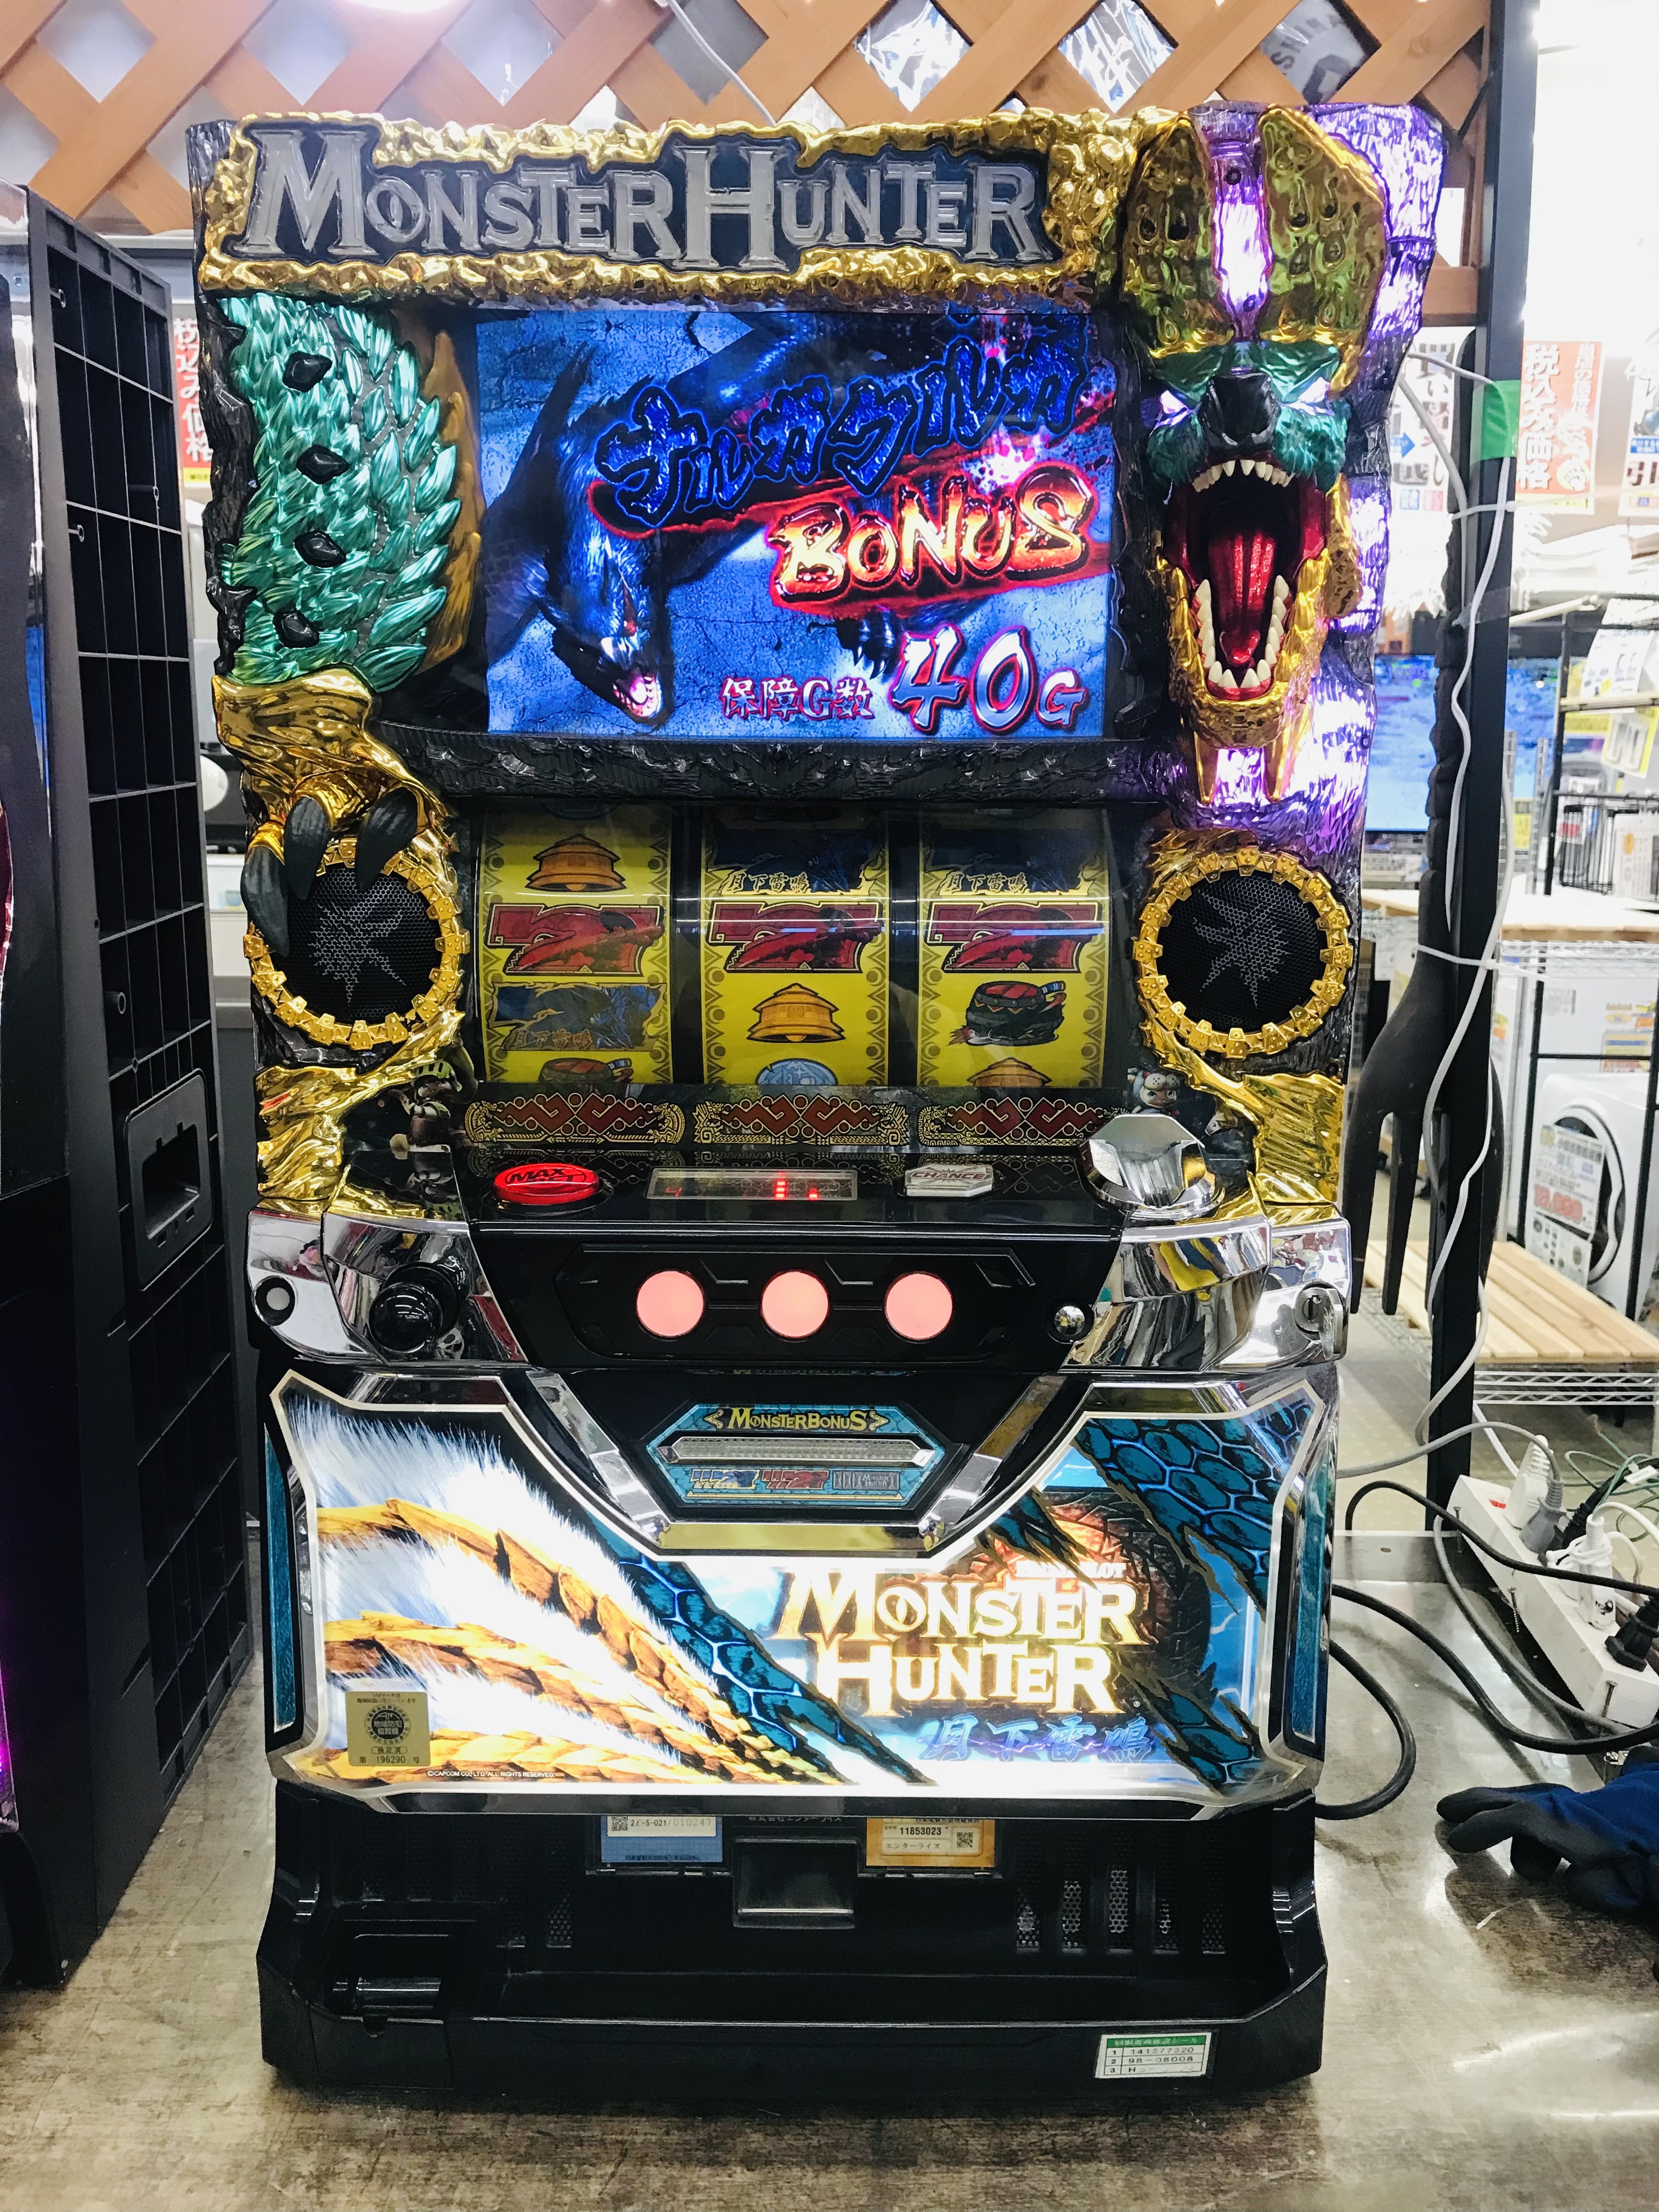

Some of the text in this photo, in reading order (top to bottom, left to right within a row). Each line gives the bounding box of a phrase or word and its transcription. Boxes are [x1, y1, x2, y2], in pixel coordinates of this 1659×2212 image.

[236, 129, 1049, 270] MONSTER HUNTER
[1516, 343, 1560, 489] 税込み価格
[770, 471, 1092, 600] BONUS
[722, 676, 874, 721] 保障G数
[726, 872, 809, 894] 月下雷鳴
[944, 872, 1027, 894] 月下雷鳴
[509, 1168, 565, 1183] MAX
[766, 1568, 1151, 1646] MONSTER
[805, 1632, 1126, 1717] HUNTER
[376, 1756, 406, 1764] 196290
[923, 1712, 1153, 1764] 月下雷鳴
[899, 1826, 942, 1836] 11853023
